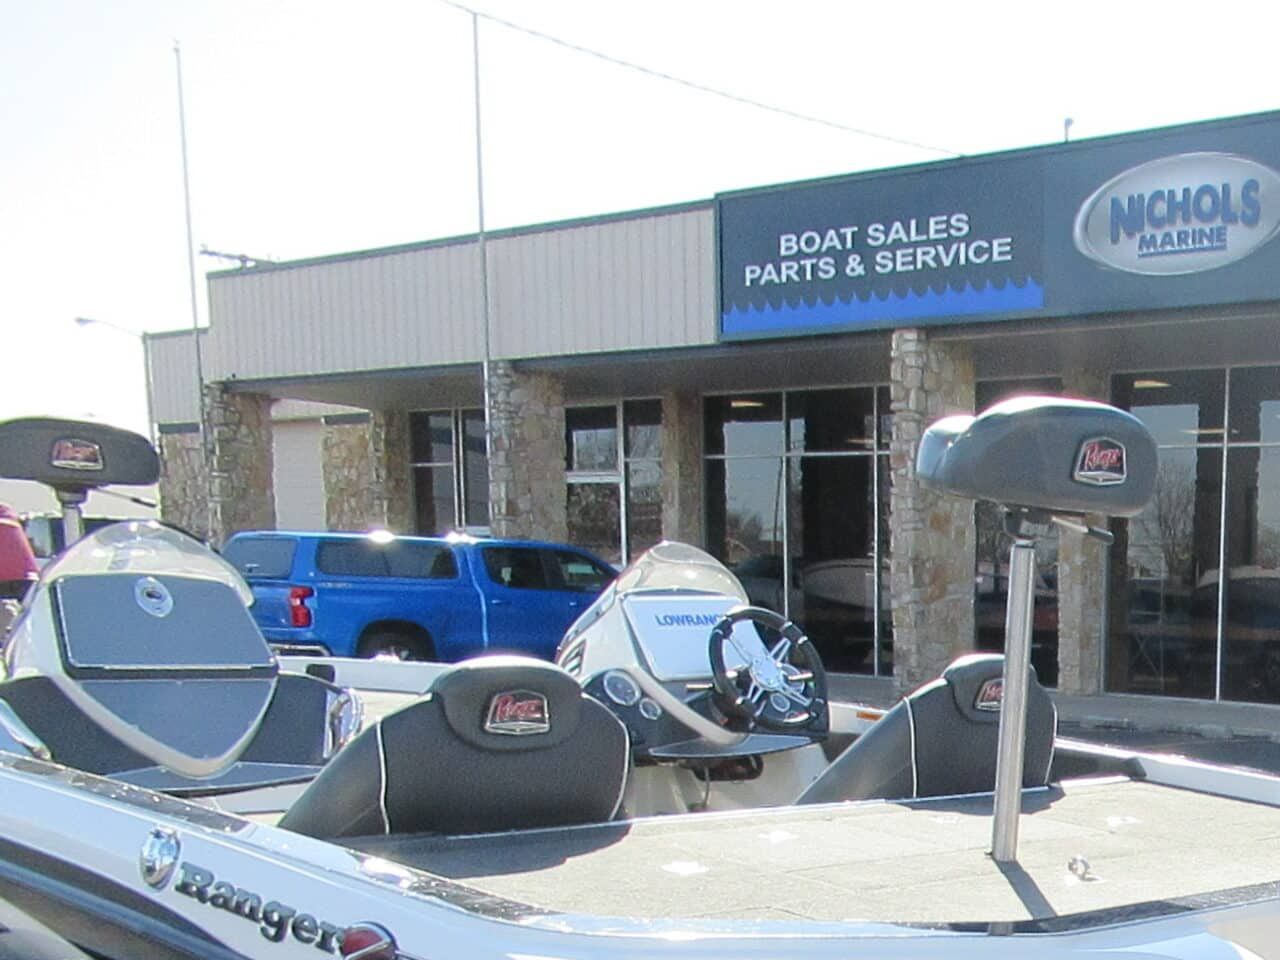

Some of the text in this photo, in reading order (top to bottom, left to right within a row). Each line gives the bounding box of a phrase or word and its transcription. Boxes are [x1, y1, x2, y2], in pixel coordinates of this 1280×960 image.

[779, 213, 970, 258] BOAT SALES
[1110, 178, 1262, 246] NICHOLS
[744, 237, 1013, 287] PARTS & SERVICE
[1137, 225, 1228, 252] MARINE
[174, 861, 347, 955] Ranger
